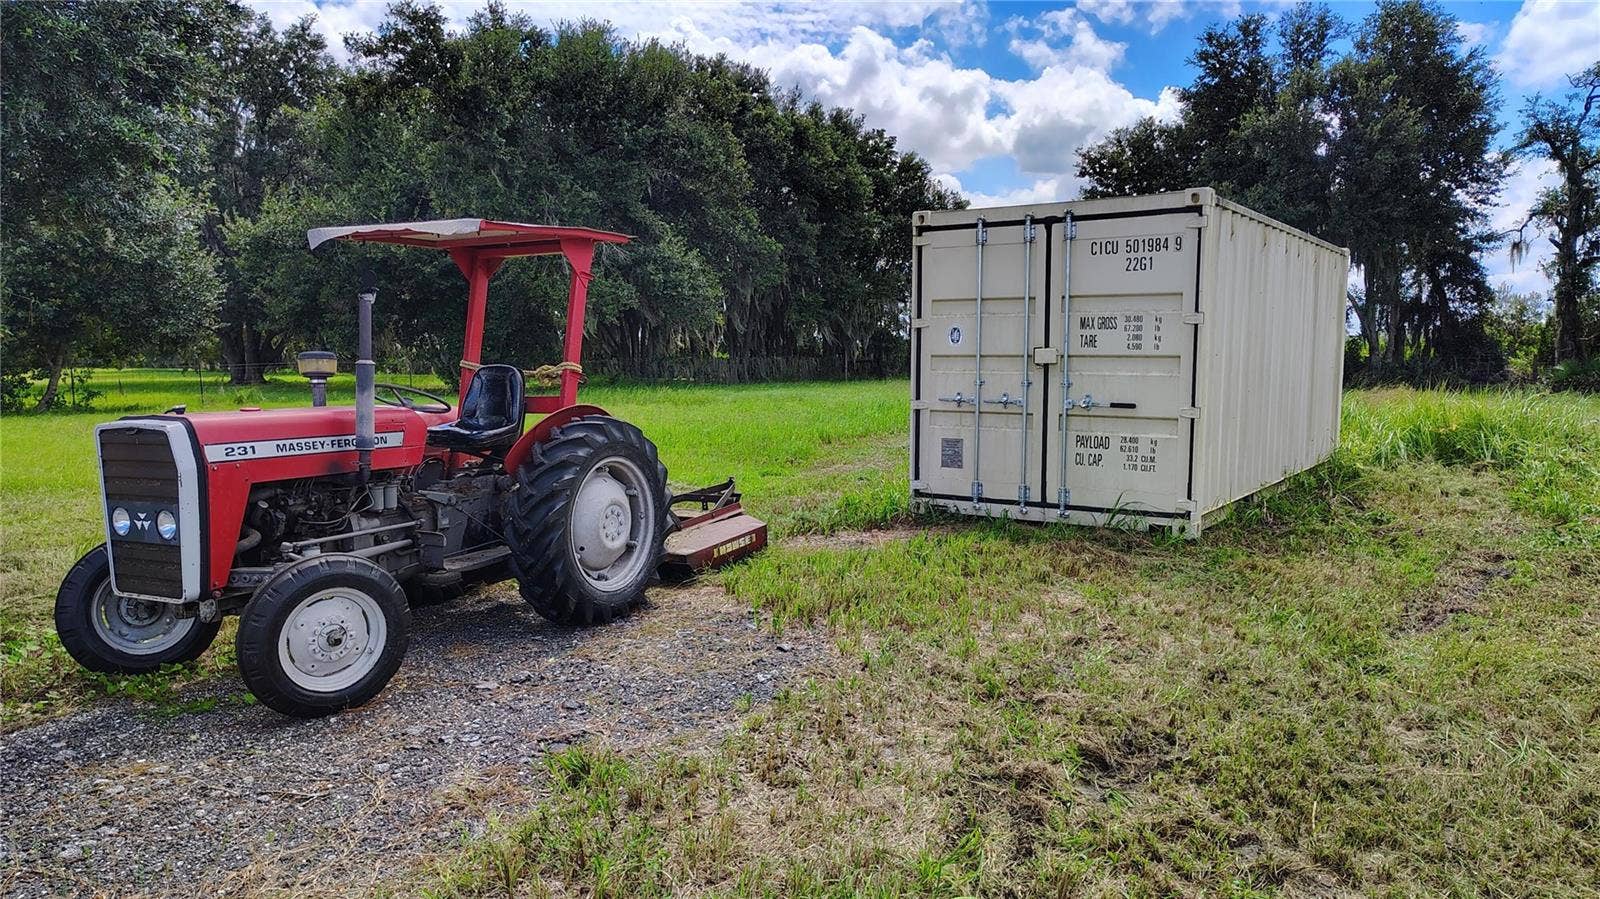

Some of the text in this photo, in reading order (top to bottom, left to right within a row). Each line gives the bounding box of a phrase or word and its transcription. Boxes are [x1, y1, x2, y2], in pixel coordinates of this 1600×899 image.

[1091, 236, 1182, 256] CICU 501984 9
[1125, 256, 1153, 272] 22G1
[1080, 316, 1096, 330] MAX
[1097, 315, 1118, 330] GROSS
[1154, 314, 1162, 324] kg
[1154, 324, 1161, 332] lb
[1080, 334, 1098, 348] TARE
[1153, 333, 1161, 343] kg
[1153, 342, 1160, 351] lb
[224, 435, 388, 457] 231 MASSEY-FERGON
[1075, 434, 1158, 450] PAYLOAD 28.400 kg
[1119, 445, 1156, 455] 62.610 lb
[1075, 452, 1086, 466] CU.
[1087, 453, 1104, 468] CAP.
[1126, 454, 1139, 463] 33.2
